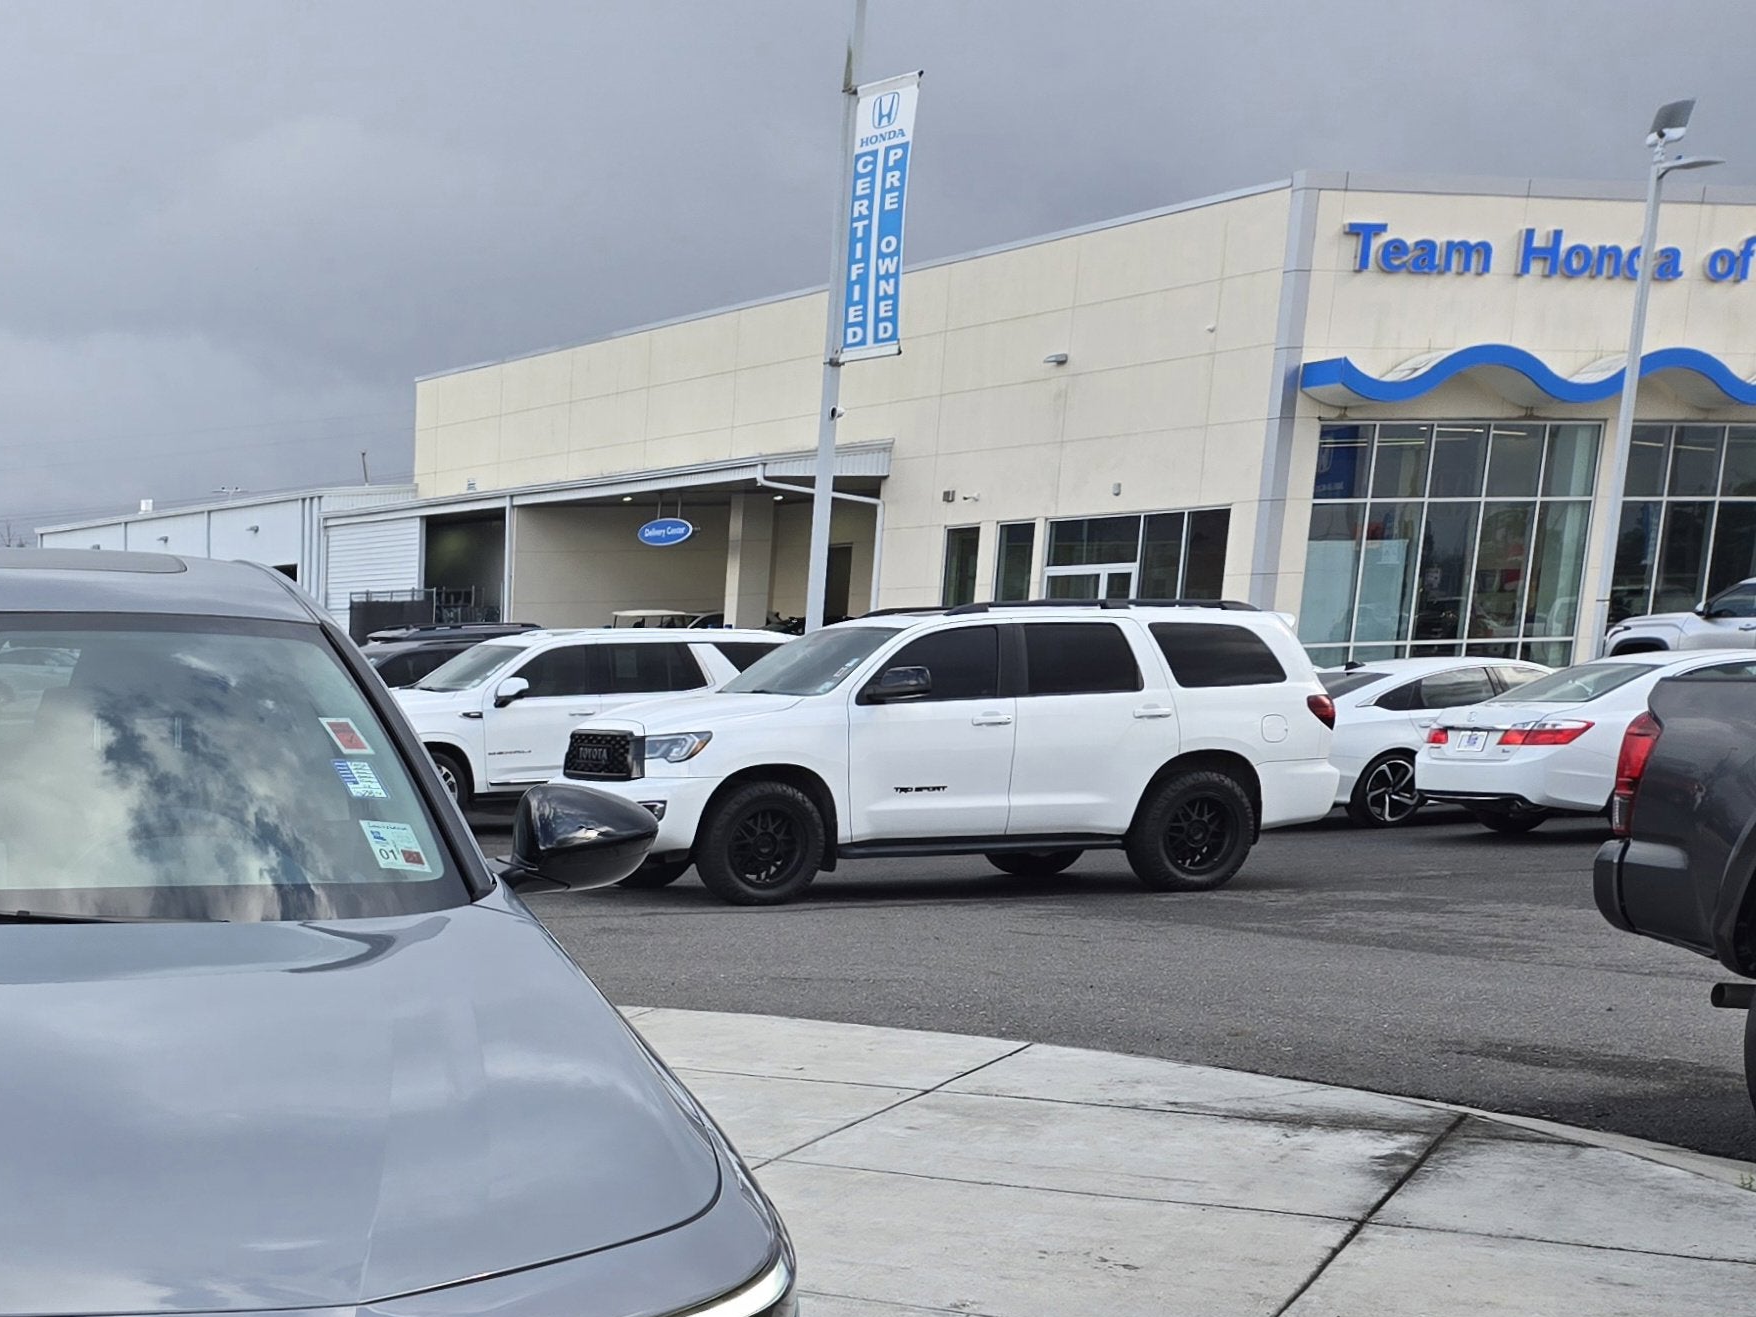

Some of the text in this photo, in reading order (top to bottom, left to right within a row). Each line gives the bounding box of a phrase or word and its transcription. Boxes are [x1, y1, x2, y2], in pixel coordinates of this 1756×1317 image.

[859, 128, 906, 148] HONDA
[845, 154, 875, 345] CERTIFIED
[877, 147, 904, 340] PRE OWNED
[1345, 222, 1494, 275] Team
[1706, 234, 1756, 283] of
[579, 746, 608, 760] TOYOTA
[893, 786, 914, 794] TRD
[378, 847, 399, 862] 01
